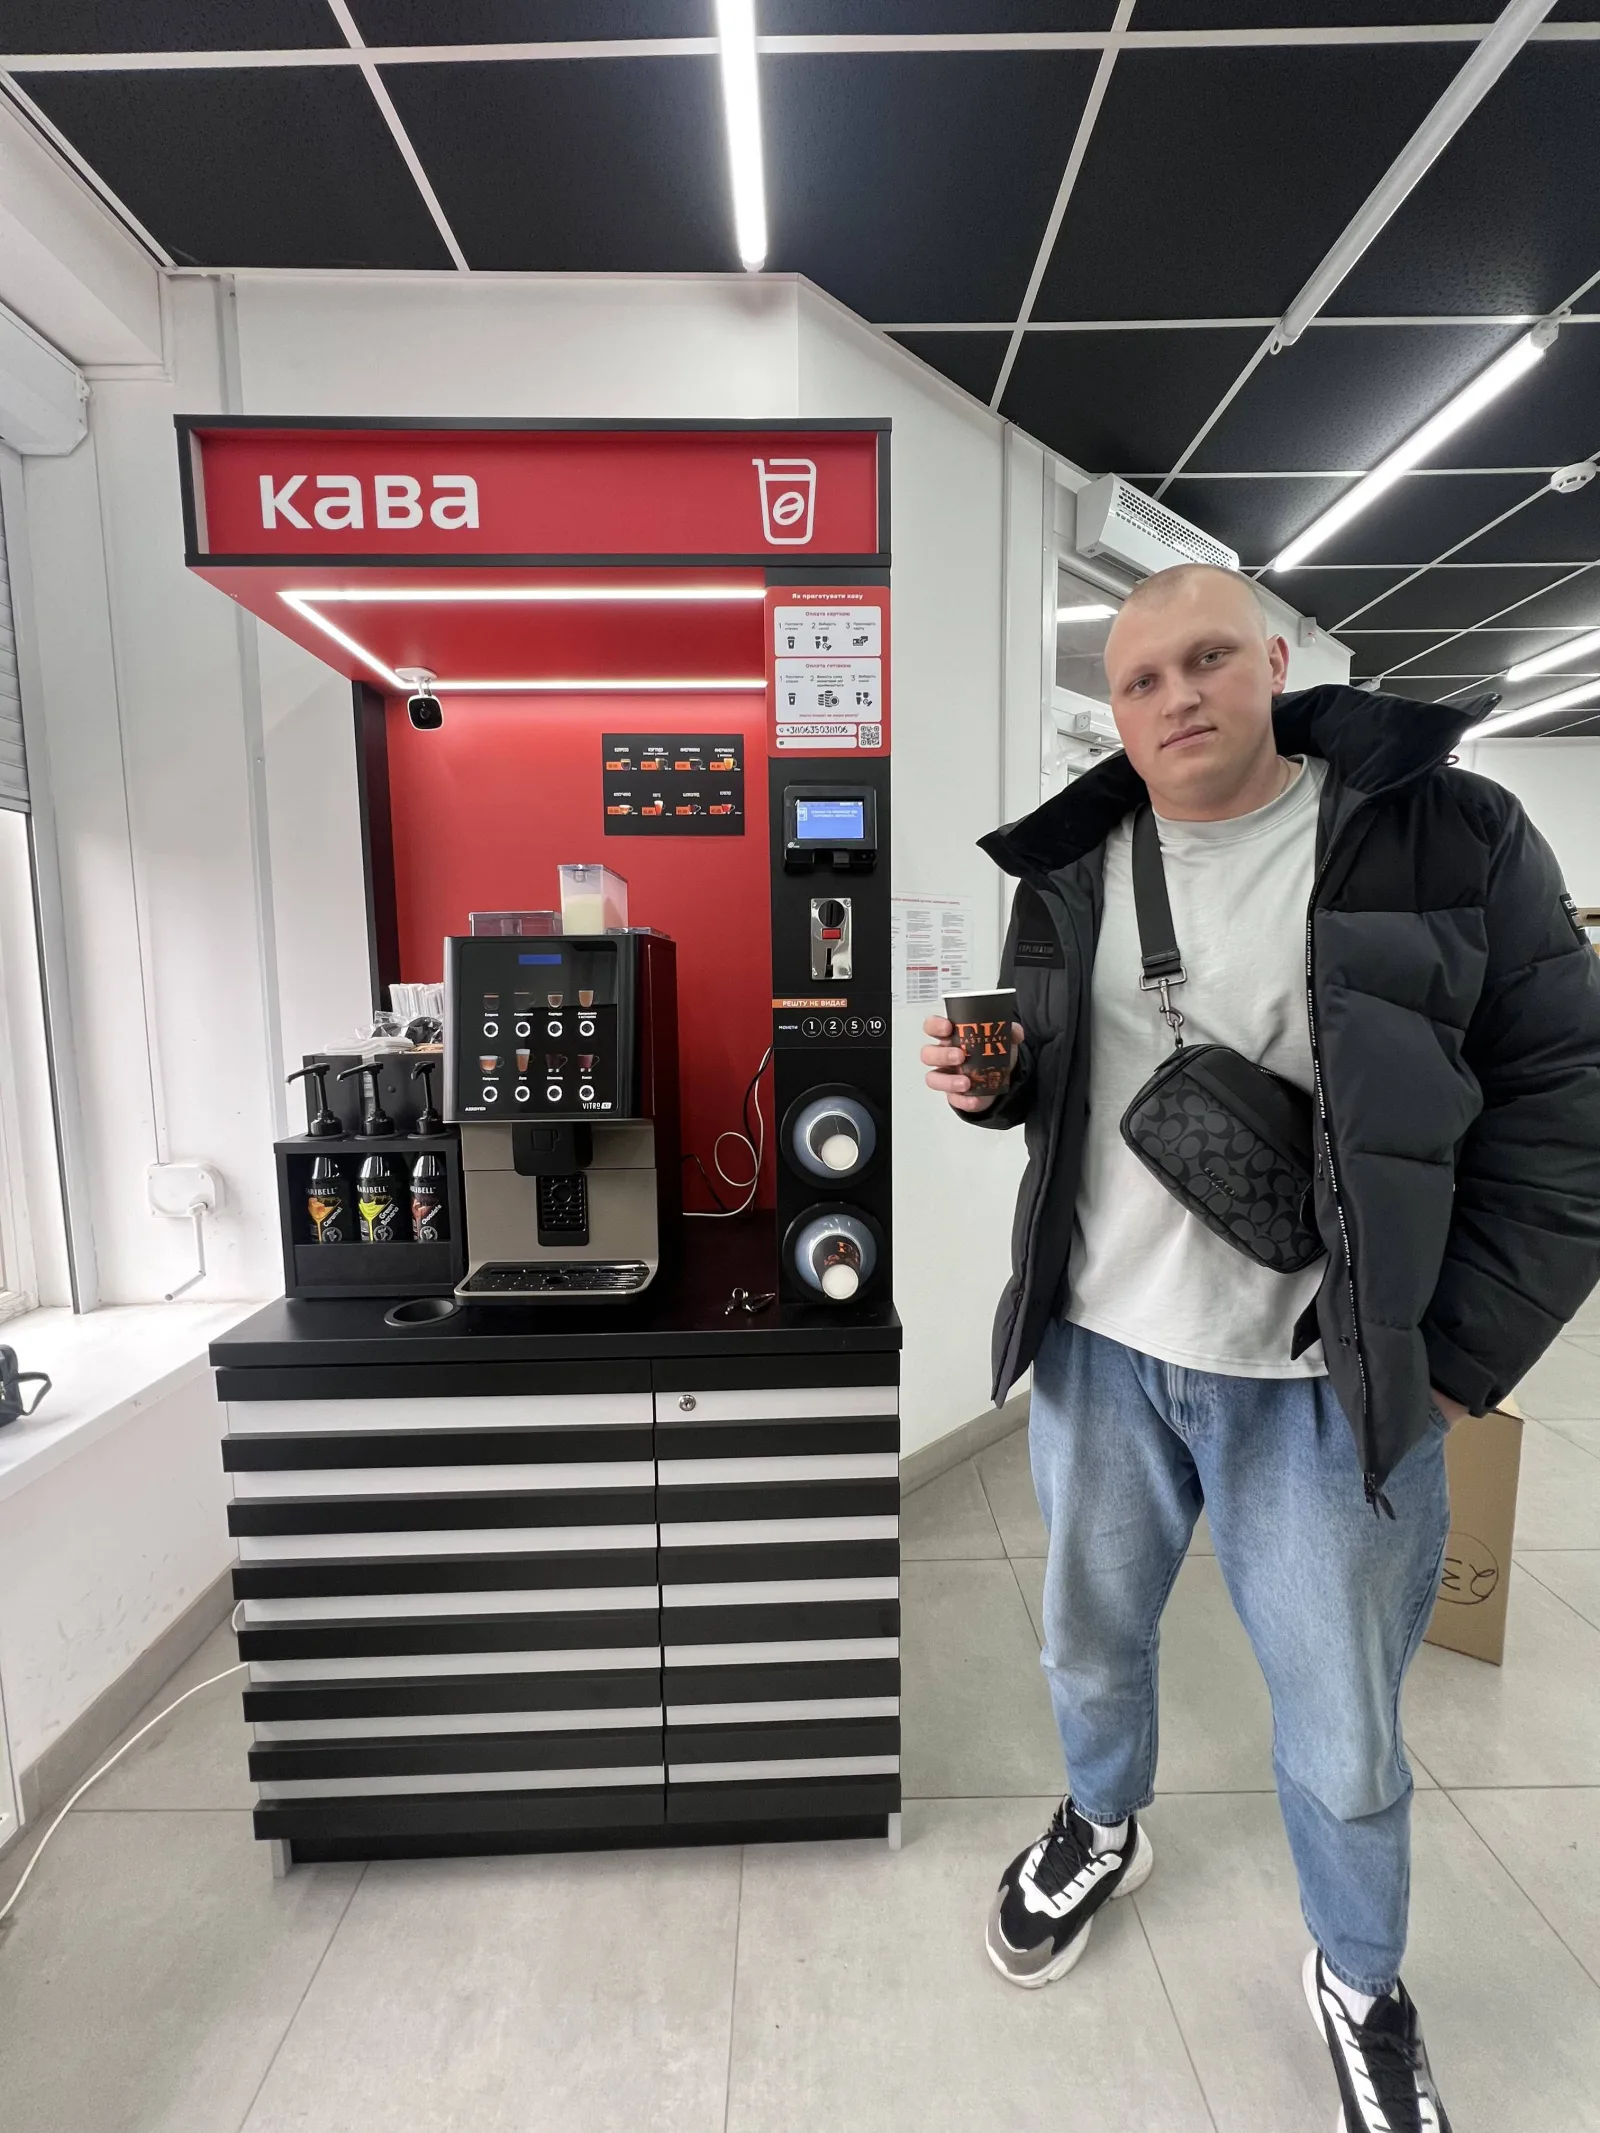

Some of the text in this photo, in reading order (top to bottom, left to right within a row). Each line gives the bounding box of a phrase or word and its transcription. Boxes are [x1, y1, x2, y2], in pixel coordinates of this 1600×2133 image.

[809, 1021, 814, 1030] 1
[830, 1021, 836, 1030] 2
[851, 1021, 858, 1029] 5
[870, 1021, 881, 1029] 10
[323, 1206, 343, 1227] Caramel
[378, 1203, 395, 1219] Green
[380, 1206, 399, 1225] Banana
[422, 1204, 442, 1224] Chocolate
